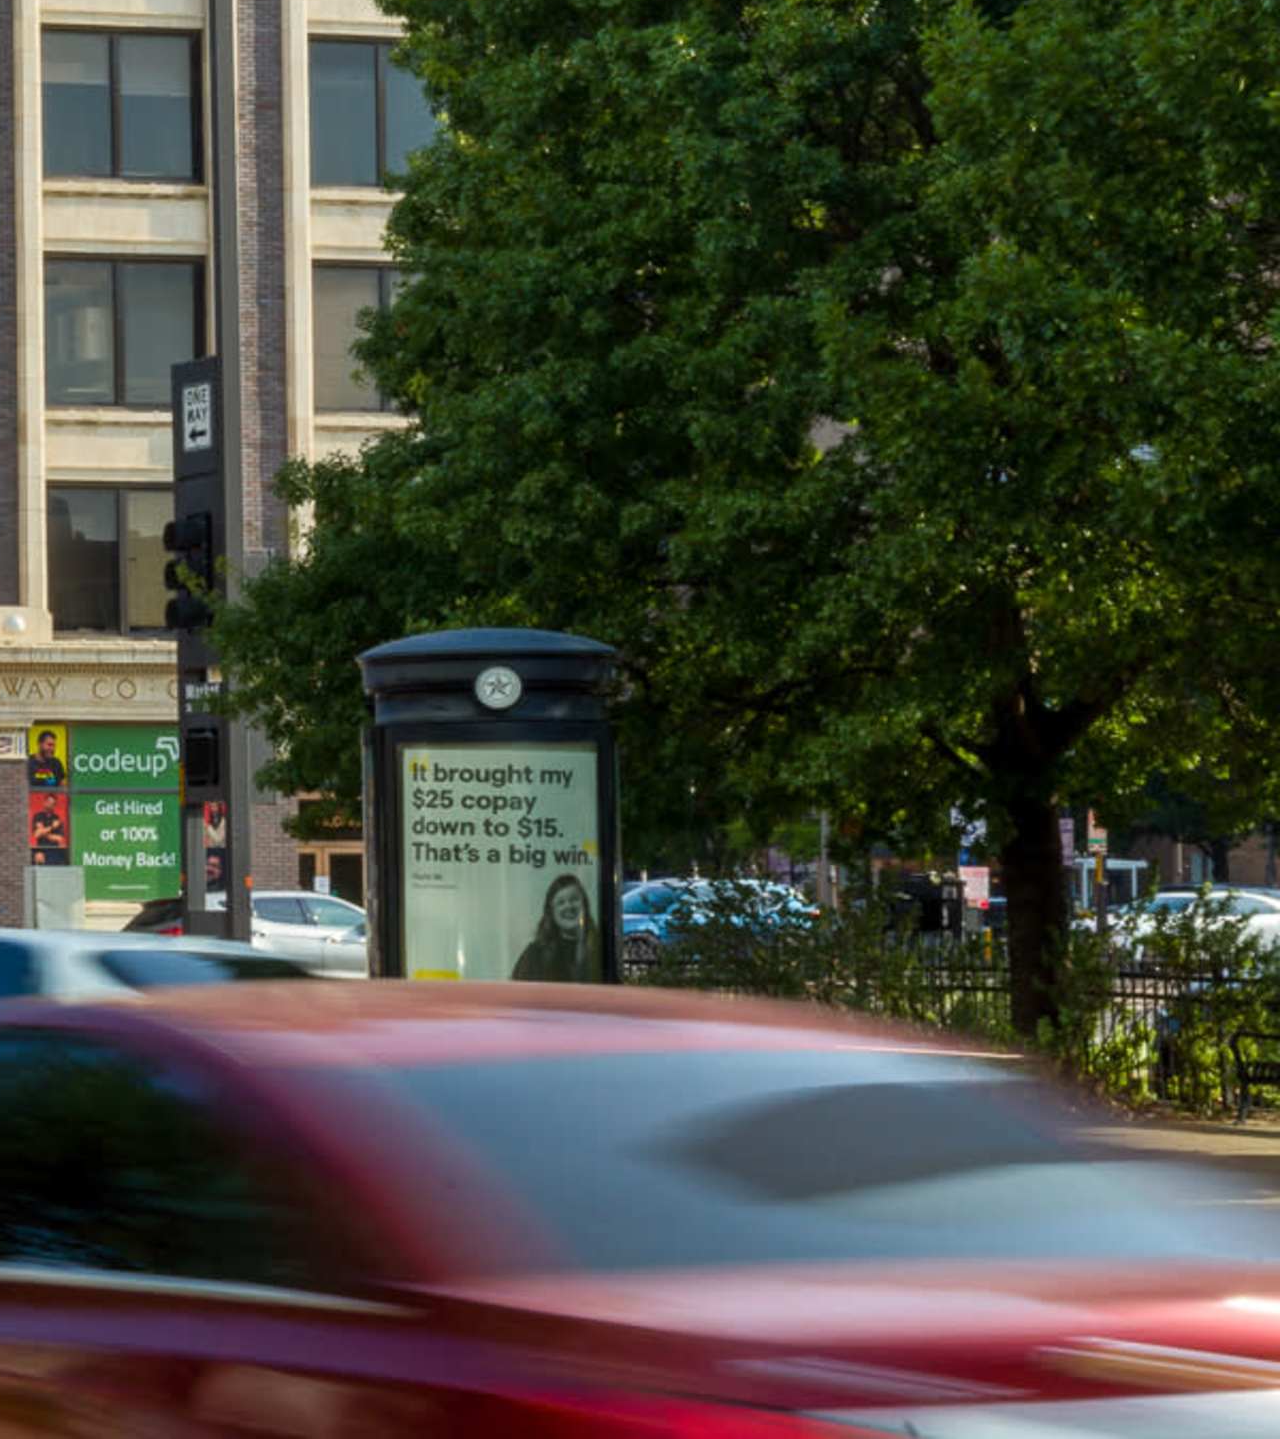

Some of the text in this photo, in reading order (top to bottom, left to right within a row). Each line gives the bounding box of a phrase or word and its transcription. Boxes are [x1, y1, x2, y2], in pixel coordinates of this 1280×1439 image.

[73, 747, 168, 778] codeup
[433, 763, 534, 789] brought
[540, 769, 574, 789] my
[95, 800, 163, 816] Get Hired
[412, 788, 537, 815] $25 copay
[100, 826, 158, 842] or 100%
[412, 815, 564, 839] down to $15.
[82, 851, 177, 871] Money Back!
[412, 842, 480, 863] That's
[487, 848, 501, 863] a
[509, 844, 546, 868] big
